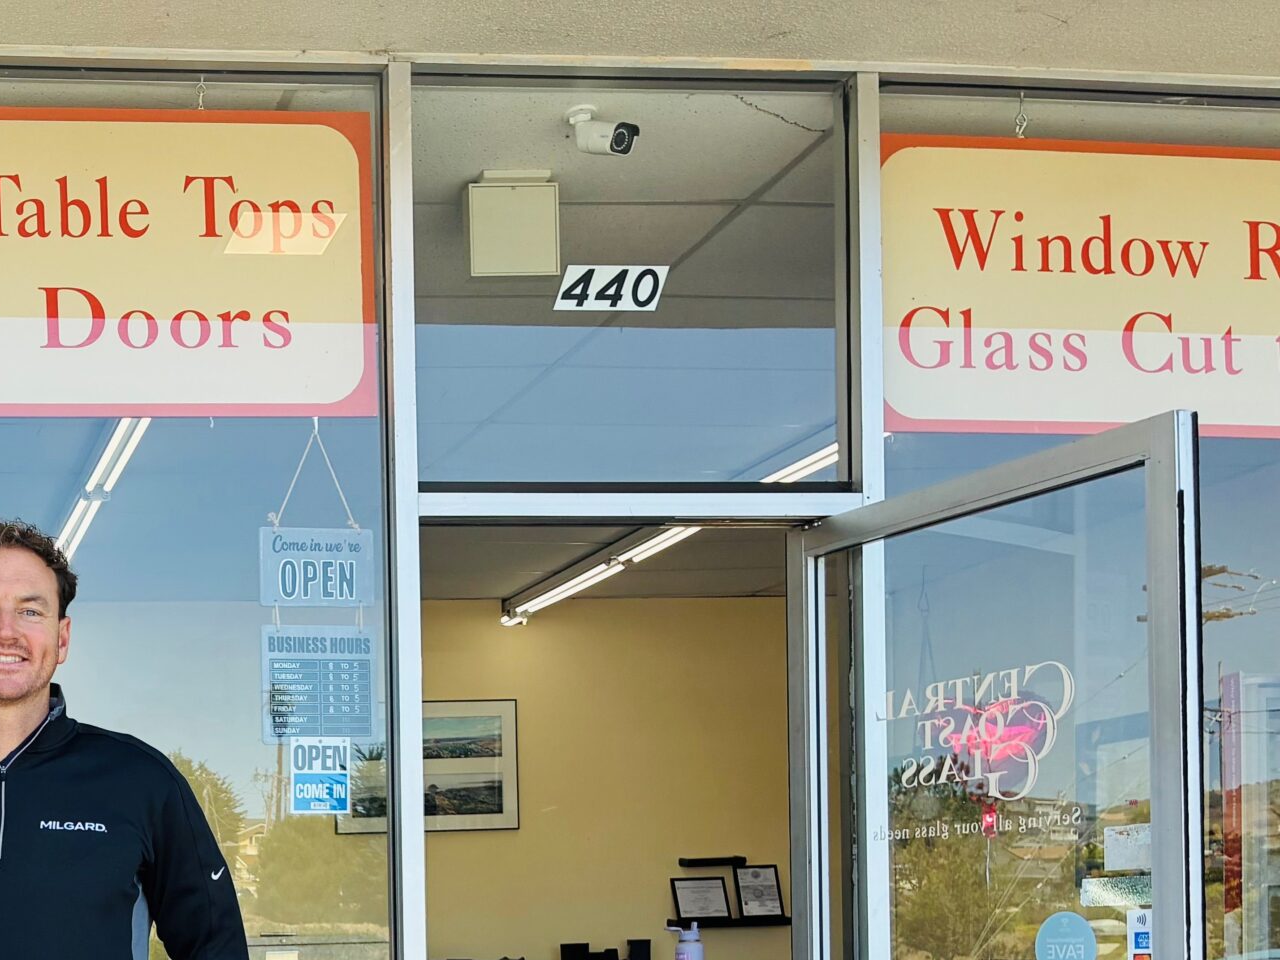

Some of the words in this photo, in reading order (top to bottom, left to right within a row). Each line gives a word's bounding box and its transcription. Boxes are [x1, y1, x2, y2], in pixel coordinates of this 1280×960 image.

[183, 175, 337, 252] Tops
[933, 208, 1210, 280] Window
[560, 268, 660, 308] 440
[38, 286, 294, 351] Doors
[898, 305, 1089, 373] Glass
[1122, 311, 1243, 376] Cut
[272, 534, 308, 553] Come
[310, 539, 325, 552] in
[279, 558, 356, 599] OPEN
[268, 636, 328, 653] BUSINESS
[330, 637, 370, 654] HOURS
[293, 744, 347, 771] OPEN
[296, 783, 330, 798] COME
[333, 783, 346, 799] IN
